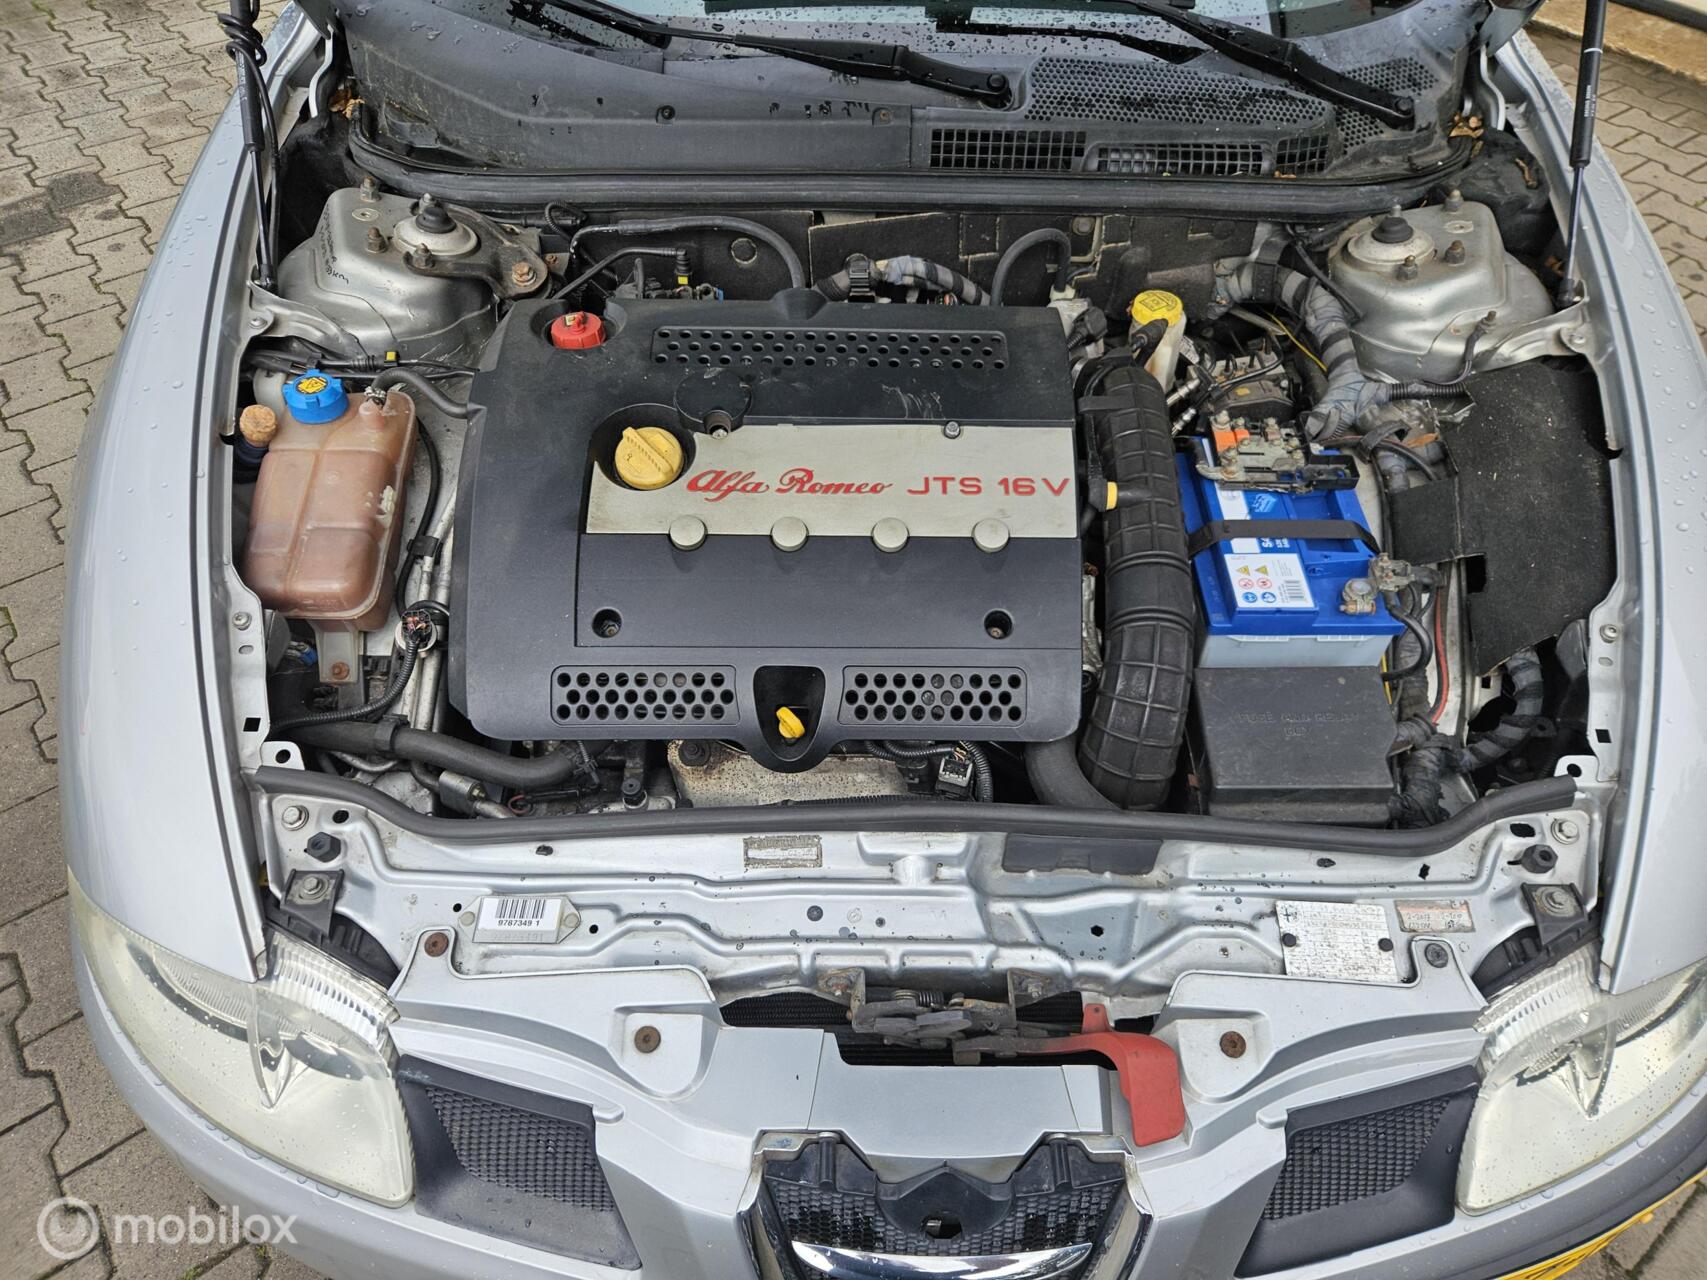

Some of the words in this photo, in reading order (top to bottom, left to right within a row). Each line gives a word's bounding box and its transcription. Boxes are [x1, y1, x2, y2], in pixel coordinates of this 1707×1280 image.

[686, 469, 769, 502] Alfa
[776, 466, 893, 497] Romeo
[907, 476, 982, 496] JTS
